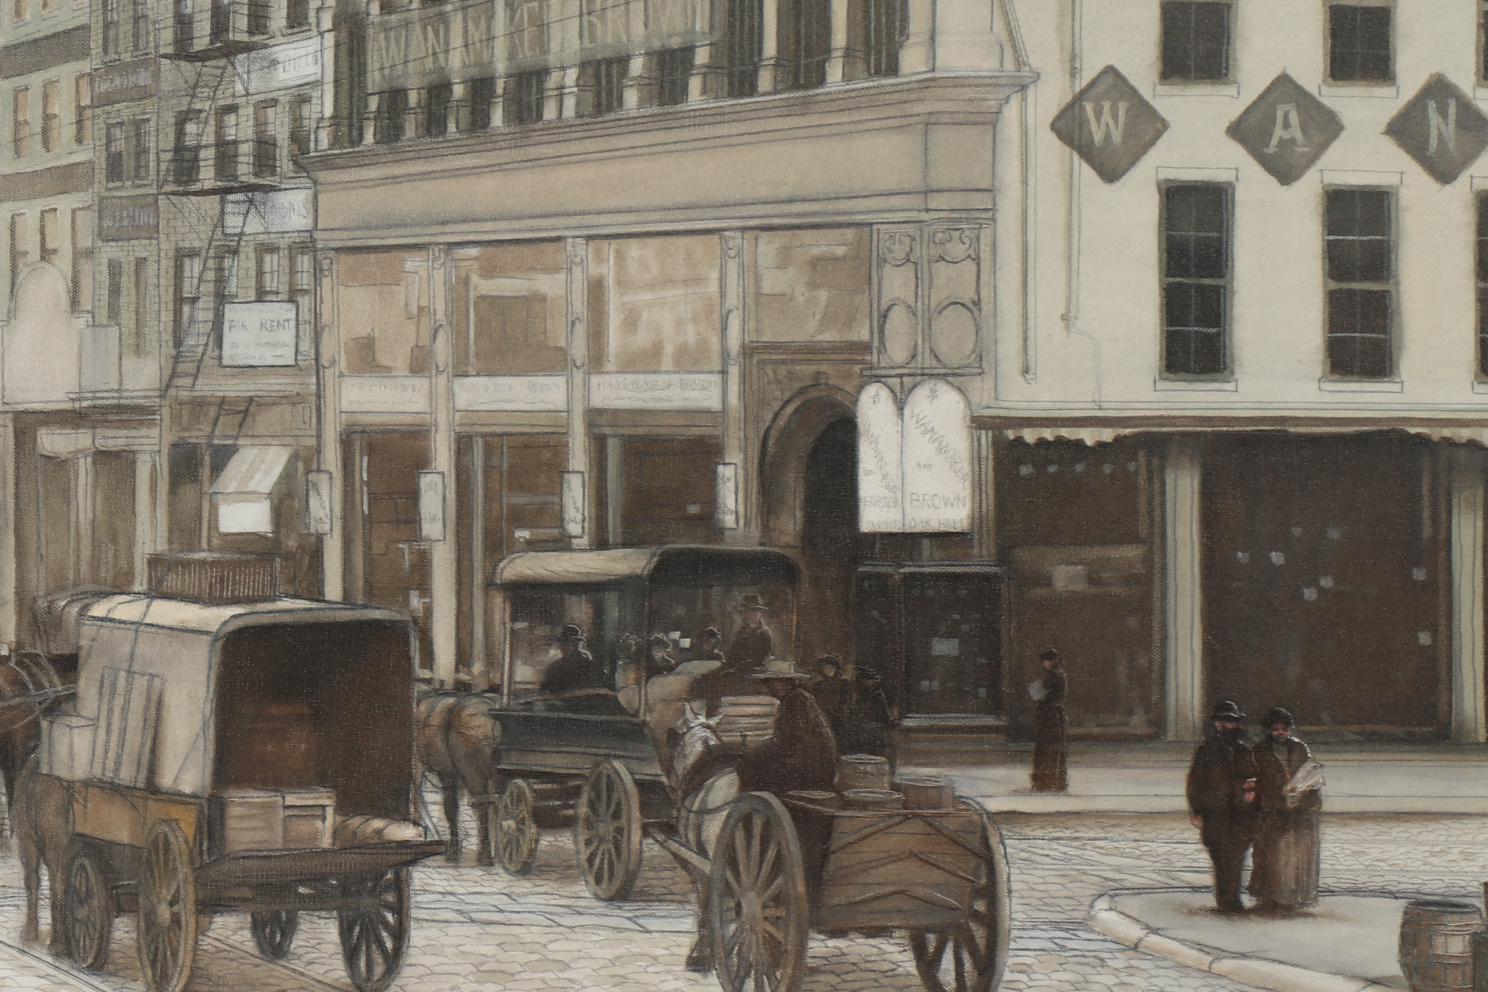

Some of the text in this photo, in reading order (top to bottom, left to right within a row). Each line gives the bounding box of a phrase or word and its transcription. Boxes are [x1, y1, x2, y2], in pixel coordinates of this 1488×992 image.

[1082, 101, 1130, 148] W
[1262, 102, 1310, 154] A
[1425, 98, 1458, 158] N
[259, 318, 292, 333] RENT
[910, 491, 968, 510] BROWN
